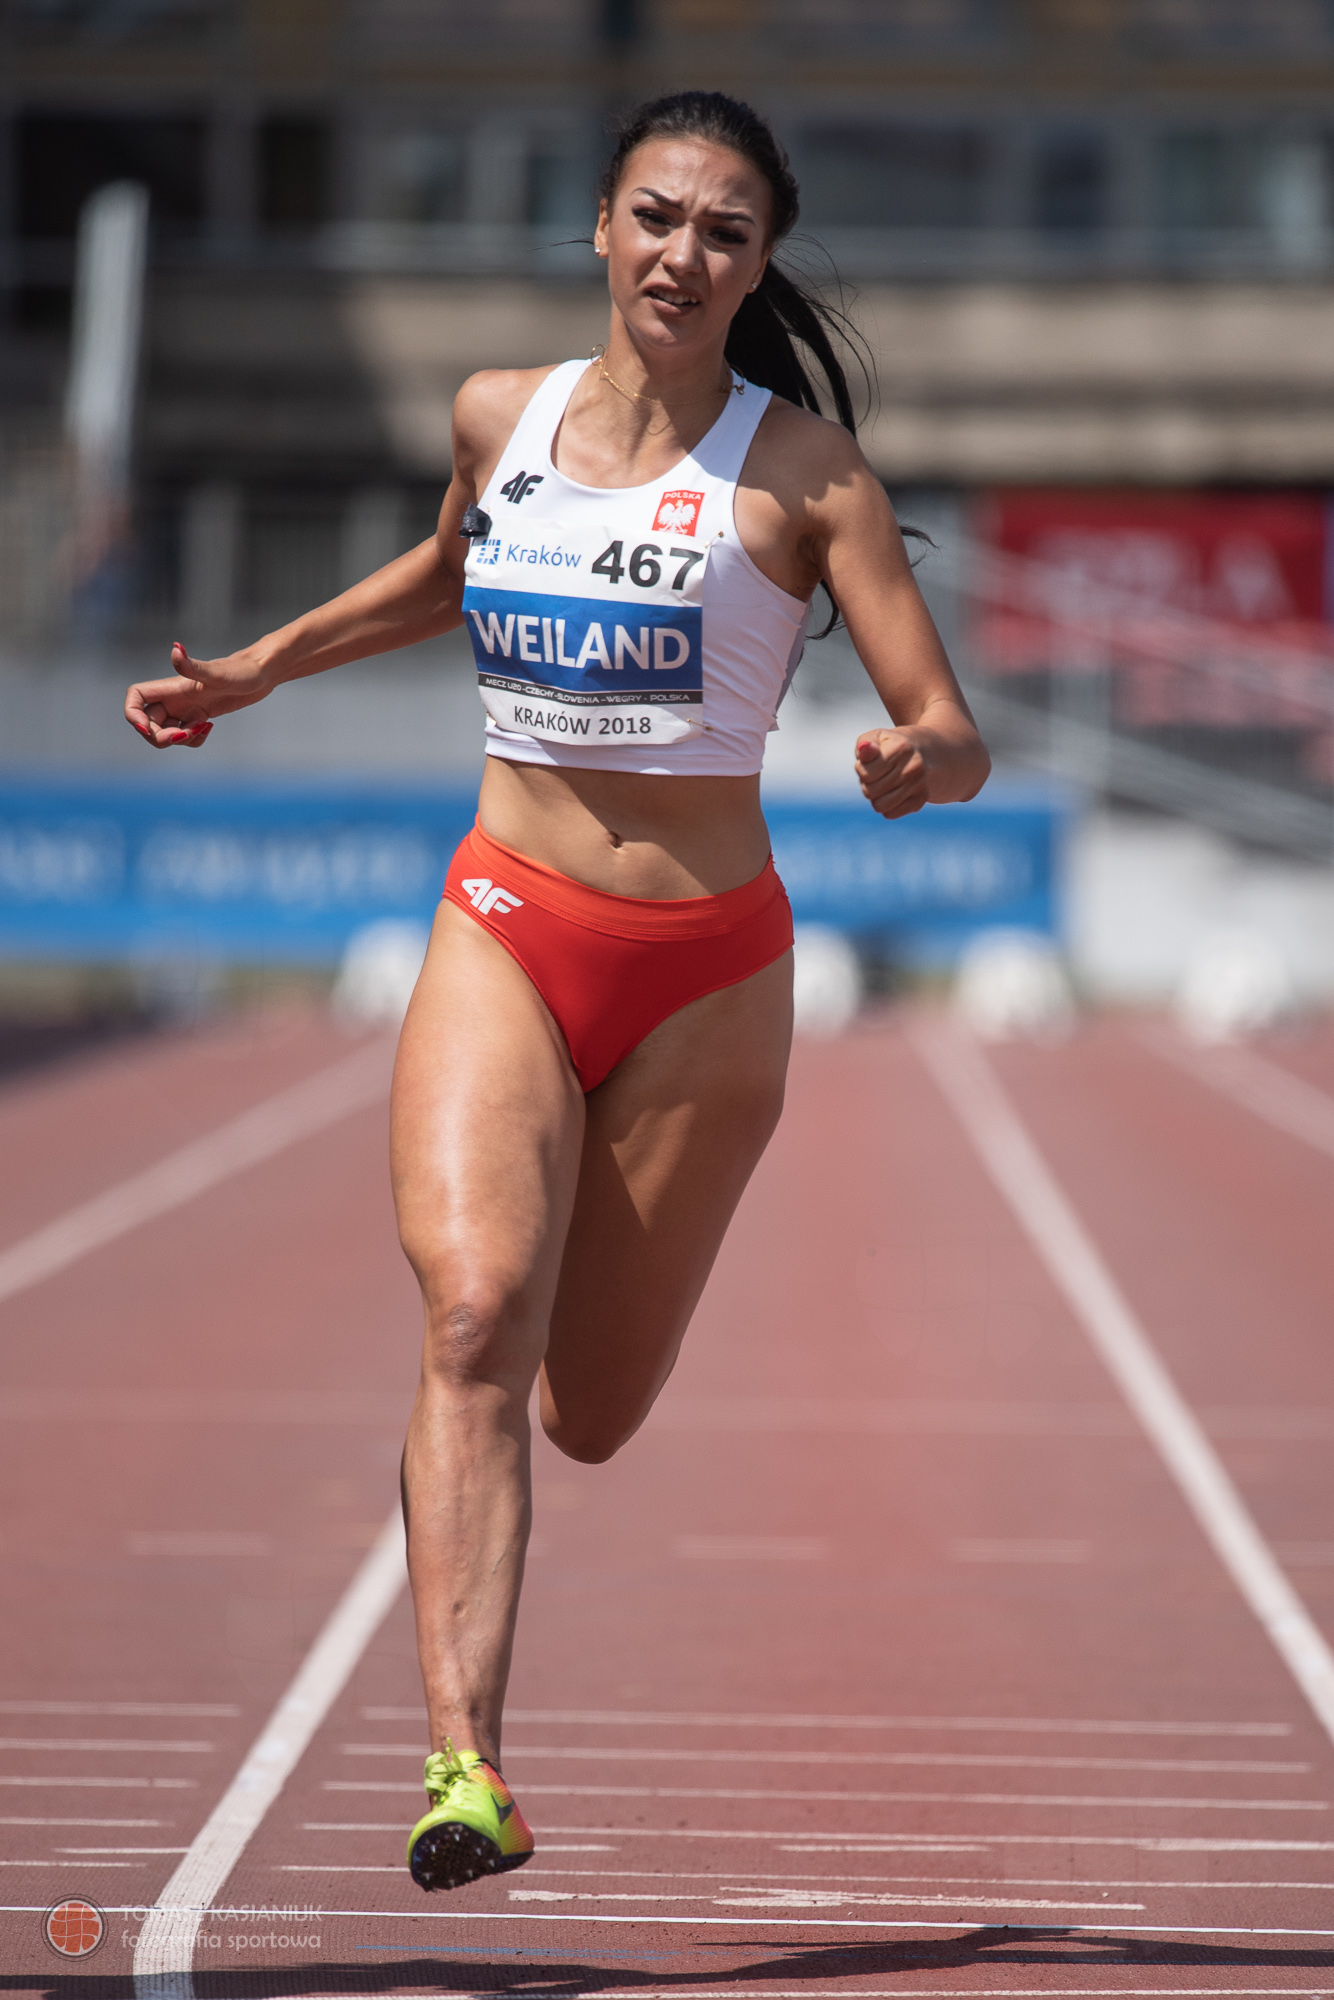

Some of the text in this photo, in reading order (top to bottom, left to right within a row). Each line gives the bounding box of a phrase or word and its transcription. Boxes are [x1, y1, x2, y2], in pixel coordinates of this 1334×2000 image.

[500, 470, 544, 505] 4F
[664, 492, 702, 500] POLSKA
[506, 543, 582, 568] Kraków
[591, 540, 704, 591] 467
[469, 609, 690, 671] WEILAND
[486, 678, 506, 689] MECZ
[507, 682, 521, 692] U20
[650, 694, 690, 702] POLSKA
[514, 705, 652, 735] KRAKÓW 2018
[461, 878, 524, 915] 4F
